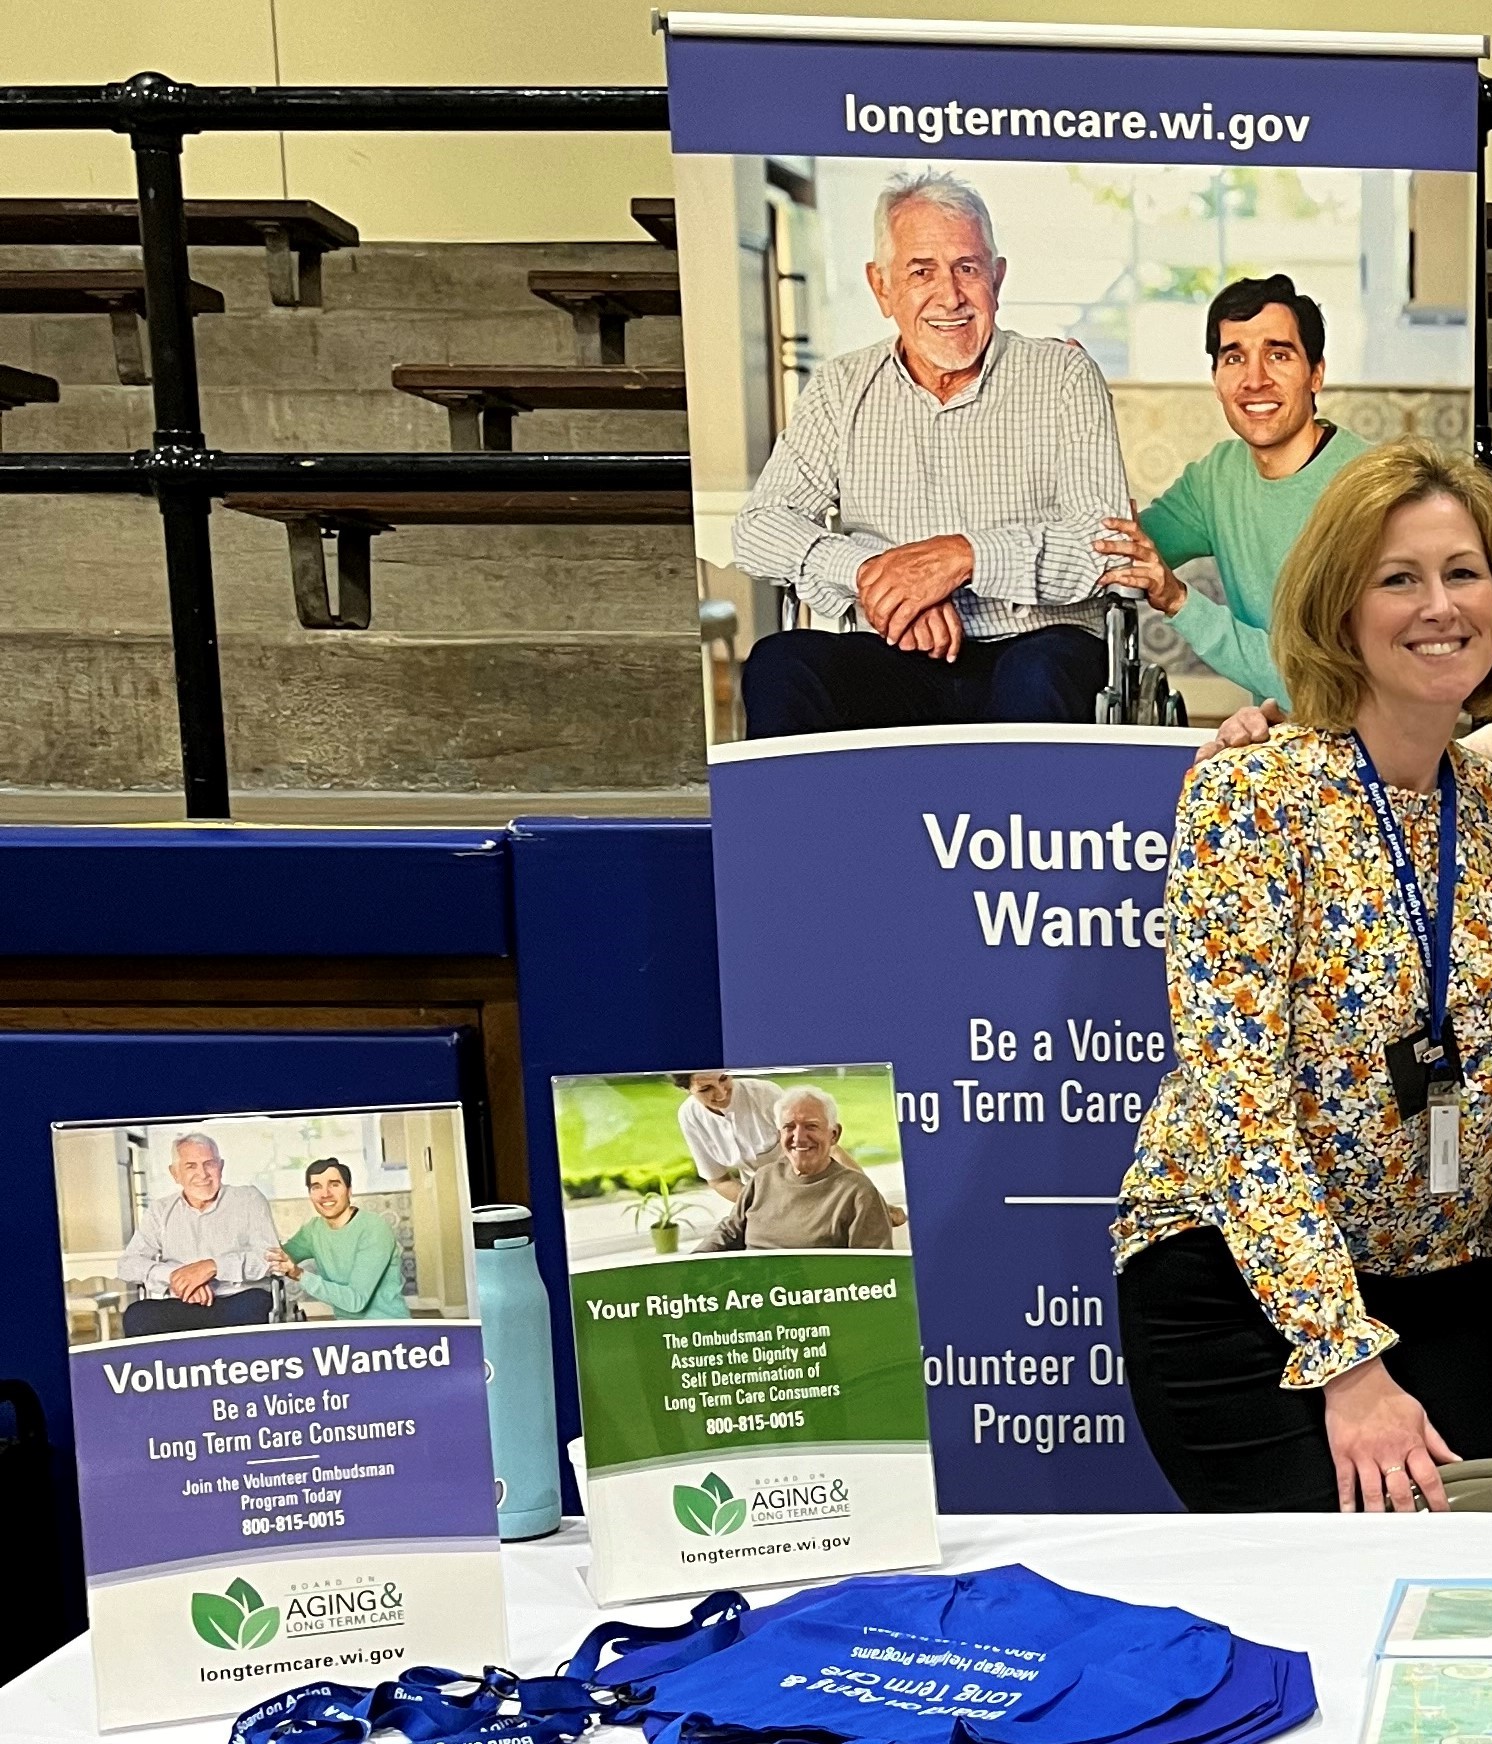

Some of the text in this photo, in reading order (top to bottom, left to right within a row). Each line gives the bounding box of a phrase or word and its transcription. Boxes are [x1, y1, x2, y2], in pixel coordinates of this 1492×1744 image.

[845, 93, 1310, 151] longtermcare.wi.gov
[1368, 782, 1406, 868] Board on Aging
[922, 813, 1168, 872] Volunte
[1404, 883, 1421, 916] Aging
[973, 891, 1167, 949] Wante
[1414, 917, 1426, 932] on
[970, 1018, 1165, 1063] Be a Voice
[896, 1080, 1142, 1134] ng Term Care
[587, 1279, 897, 1320] Your Rights Are Guaranteed
[1025, 1285, 1103, 1327] Join
[663, 1325, 831, 1350] The Ombudsman Program
[103, 1337, 451, 1394] Volunteers Wanted
[671, 1342, 828, 1369] Assures the Dignity and
[920, 1344, 1075, 1386] olunteer
[681, 1362, 821, 1390] Self Determination of
[212, 1389, 350, 1422] Be a Voice for
[664, 1383, 840, 1413] Long Term Care Consumers
[148, 1417, 416, 1462] Long Term Care Consumers
[706, 1411, 805, 1436] 800-815-0015
[973, 1403, 1125, 1454] Program
[182, 1461, 395, 1497] Join the Volunteer Ombudsman
[240, 1487, 343, 1512] Program Today
[751, 1503, 850, 1522] LONG TERM CARE
[241, 1509, 346, 1536] 800-815-0015
[681, 1536, 852, 1564] longtermcare.wi.gov
[286, 1609, 405, 1633] LONG TERM CARE
[200, 1647, 405, 1683] longtermcare.wi.gov
[850, 1646, 915, 1666] Programs
[973, 1660, 1039, 1681] Medigap
[884, 1677, 951, 1702] Term
[953, 1683, 1022, 1707] Long
